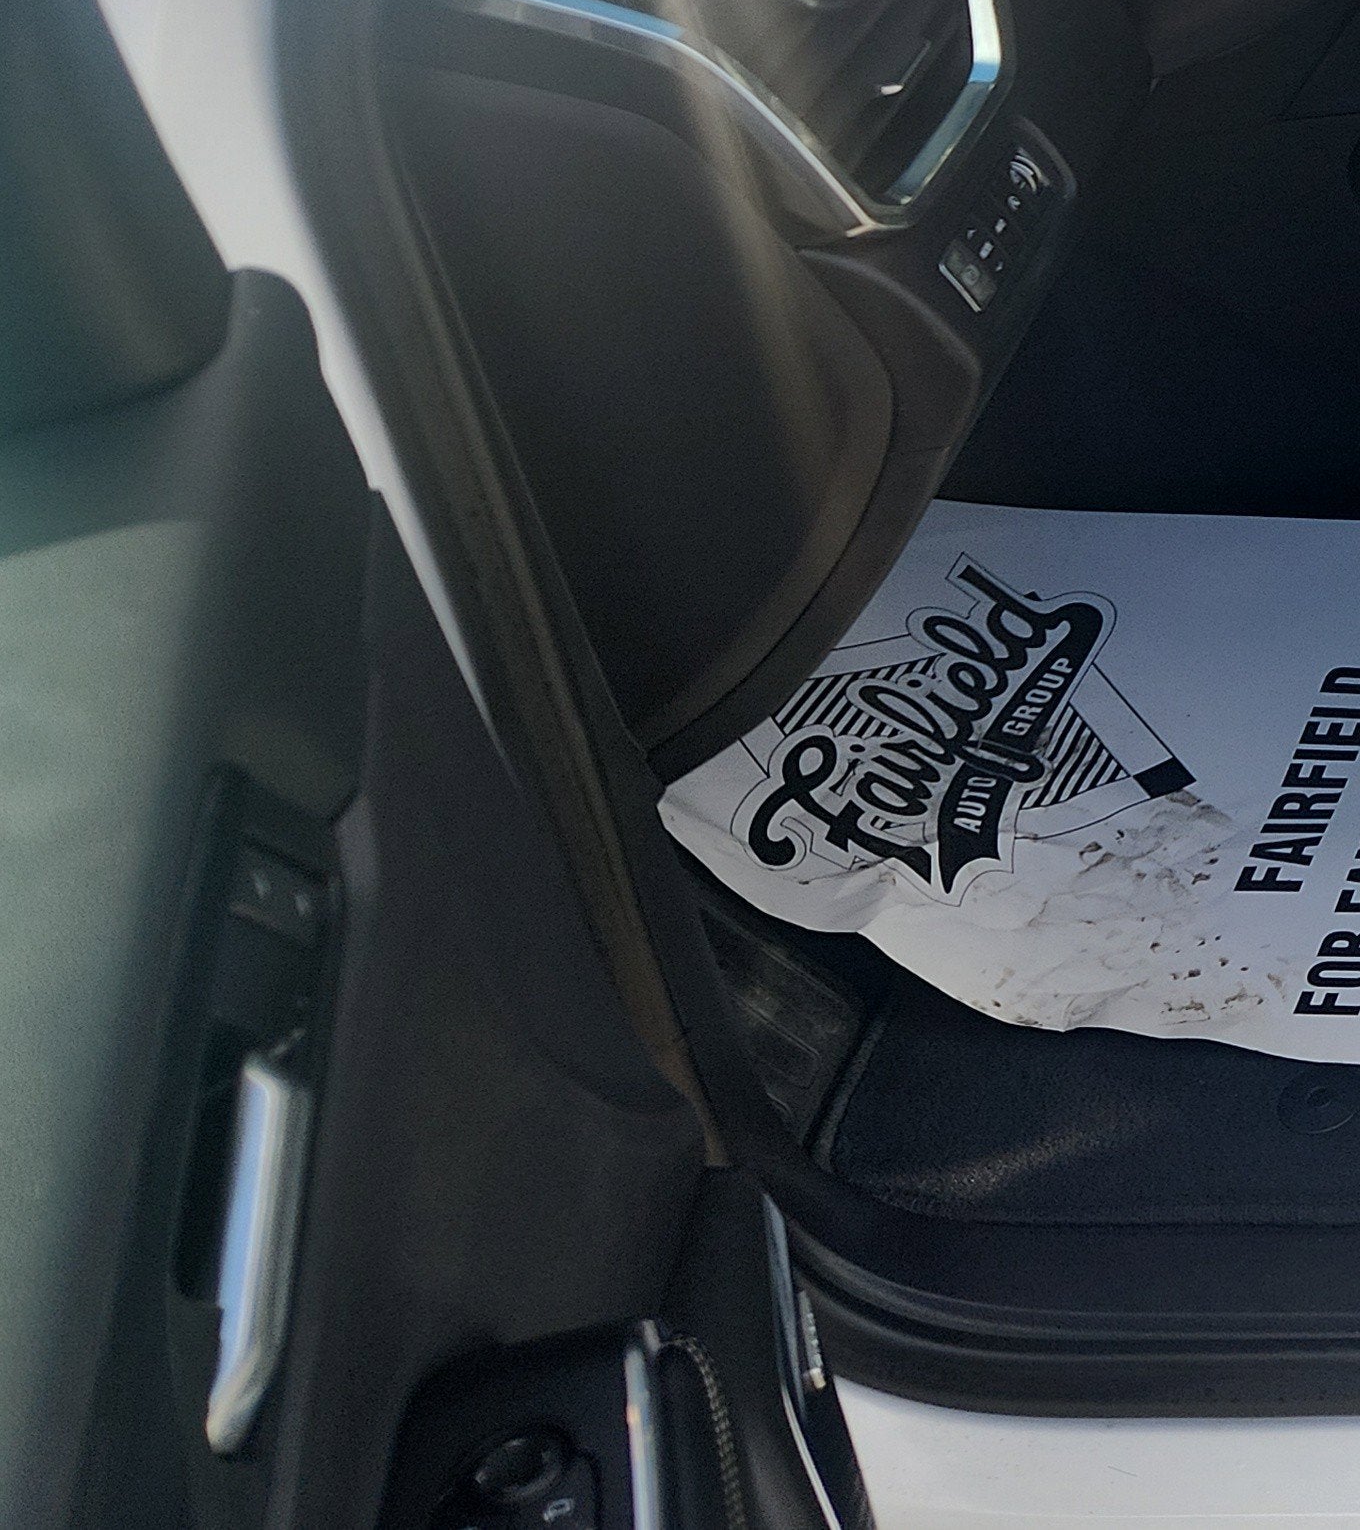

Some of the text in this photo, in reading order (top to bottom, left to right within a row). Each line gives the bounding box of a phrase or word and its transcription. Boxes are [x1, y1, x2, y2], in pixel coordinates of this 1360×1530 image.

[749, 564, 1062, 885] Fairfield
[953, 657, 1075, 835] AUTO GROUP
